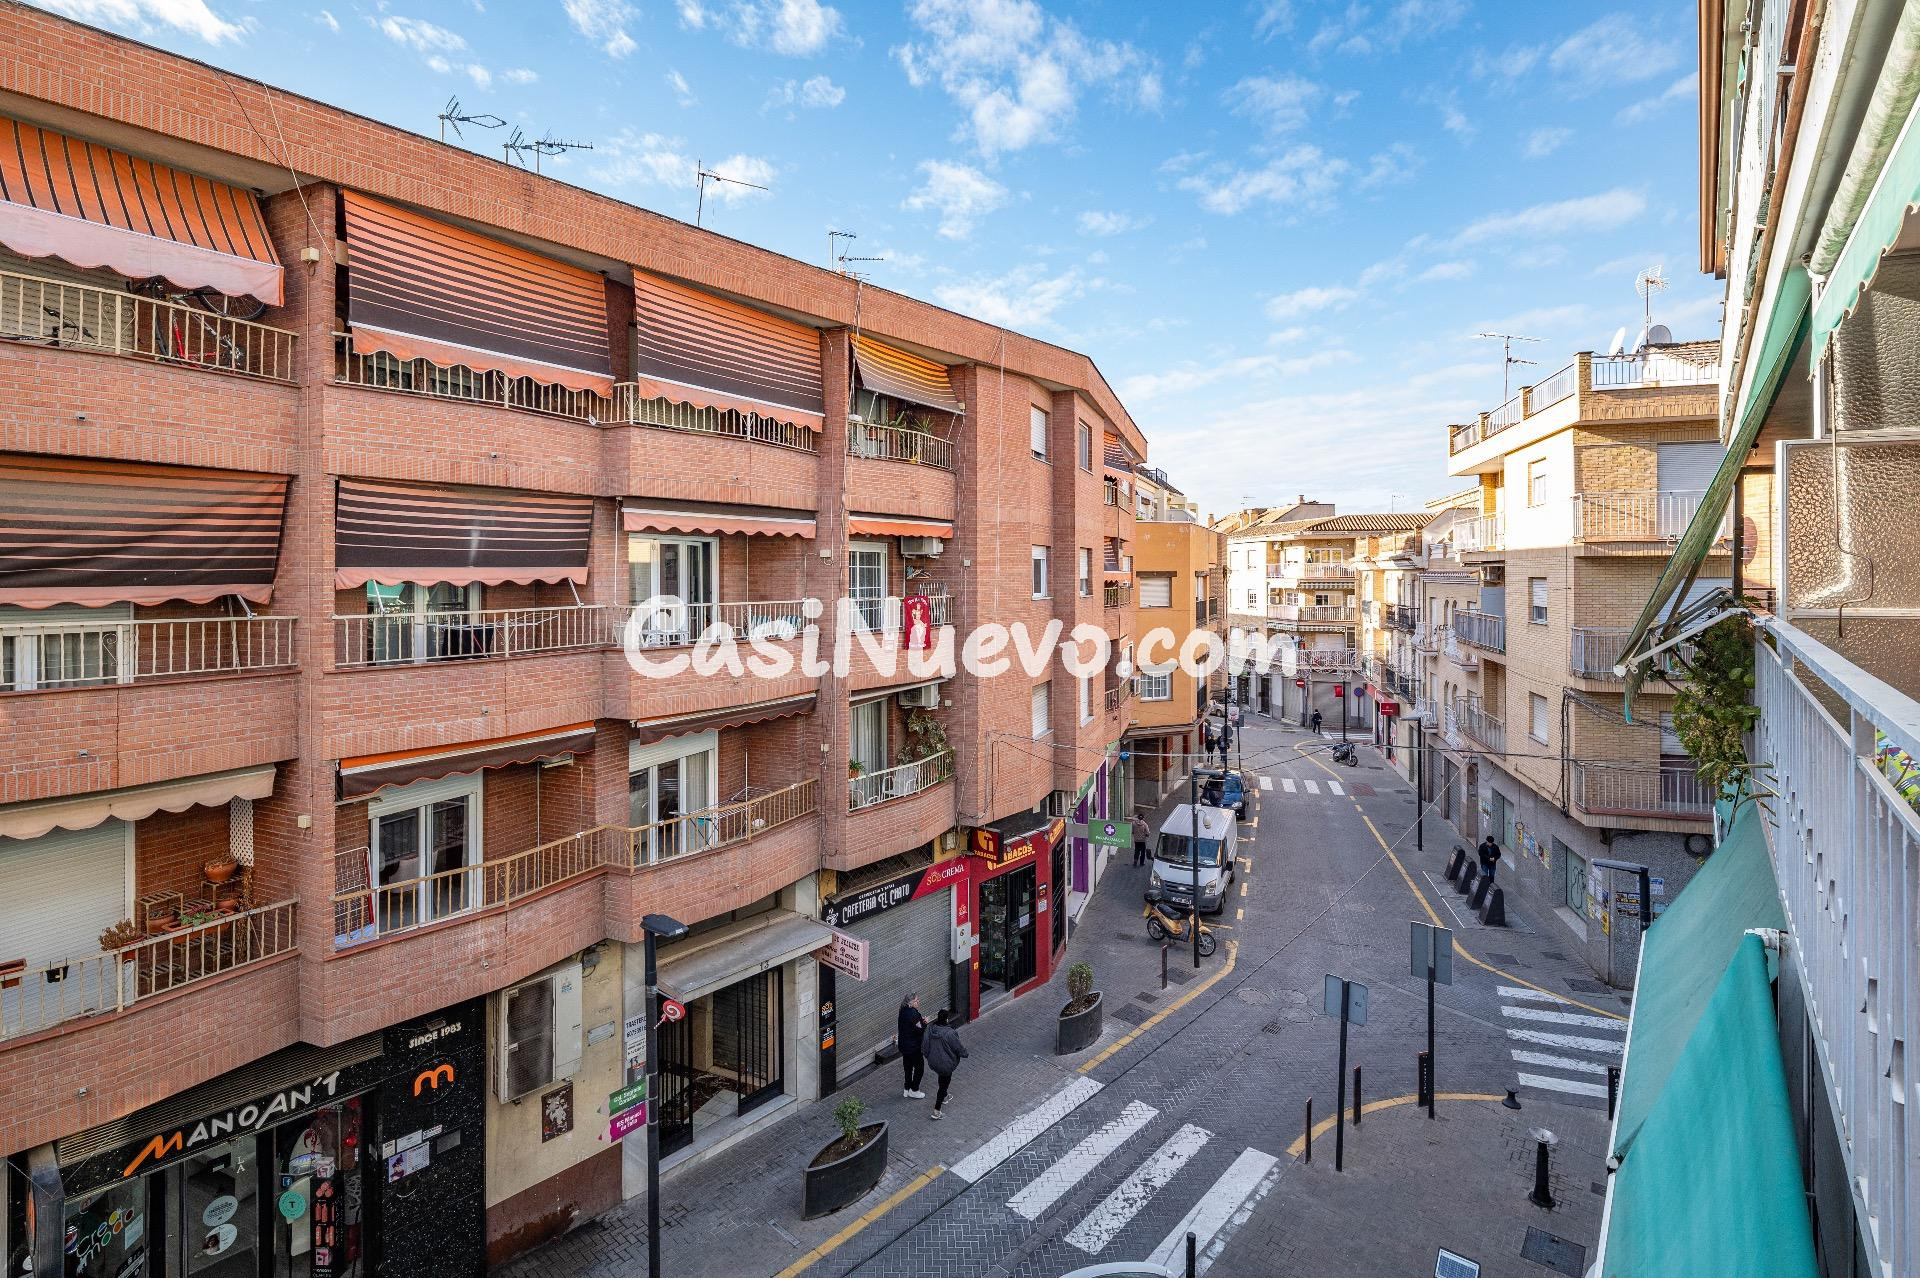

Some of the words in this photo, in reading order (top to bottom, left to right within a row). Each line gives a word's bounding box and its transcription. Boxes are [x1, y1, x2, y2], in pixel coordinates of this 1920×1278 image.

[1003, 843, 1033, 861] ABACOS
[941, 863, 965, 879] CREMA
[842, 894, 877, 924] CAFETERIA
[760, 960, 770, 971] 13
[624, 1110, 642, 1125] Manuel
